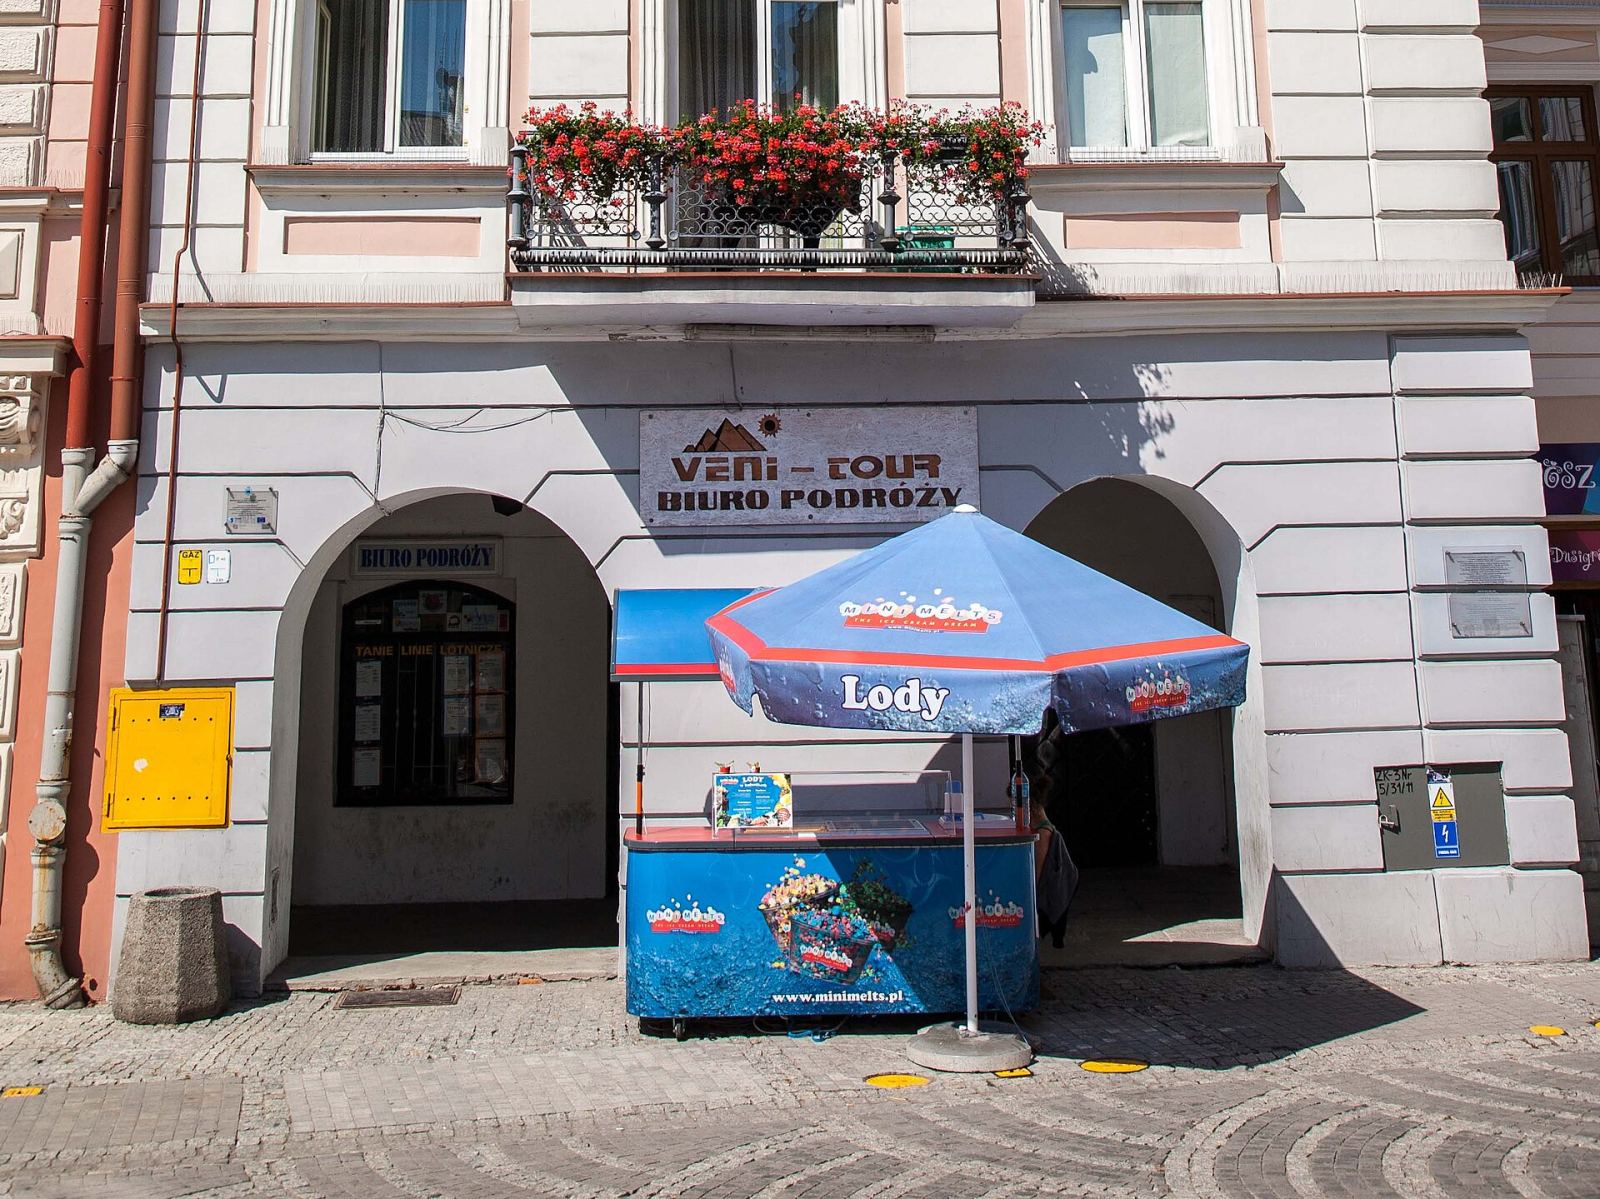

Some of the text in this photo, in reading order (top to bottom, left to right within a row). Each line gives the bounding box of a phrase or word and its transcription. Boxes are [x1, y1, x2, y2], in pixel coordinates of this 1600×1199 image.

[828, 454, 942, 480] TOUR
[657, 480, 962, 511] BIURO PODRÓŻY
[182, 551, 200, 559] GAZ
[361, 544, 493, 568] BIURO PODRÓŻY
[1549, 547, 1600, 571] Dusigr
[841, 603, 999, 621] MINI MELTS
[355, 644, 503, 656] TANIE LINIE LOTNICZE
[840, 674, 950, 721] Lody
[648, 909, 724, 922] MINI MELTS
[772, 990, 903, 1004] www.minimelts.pl
